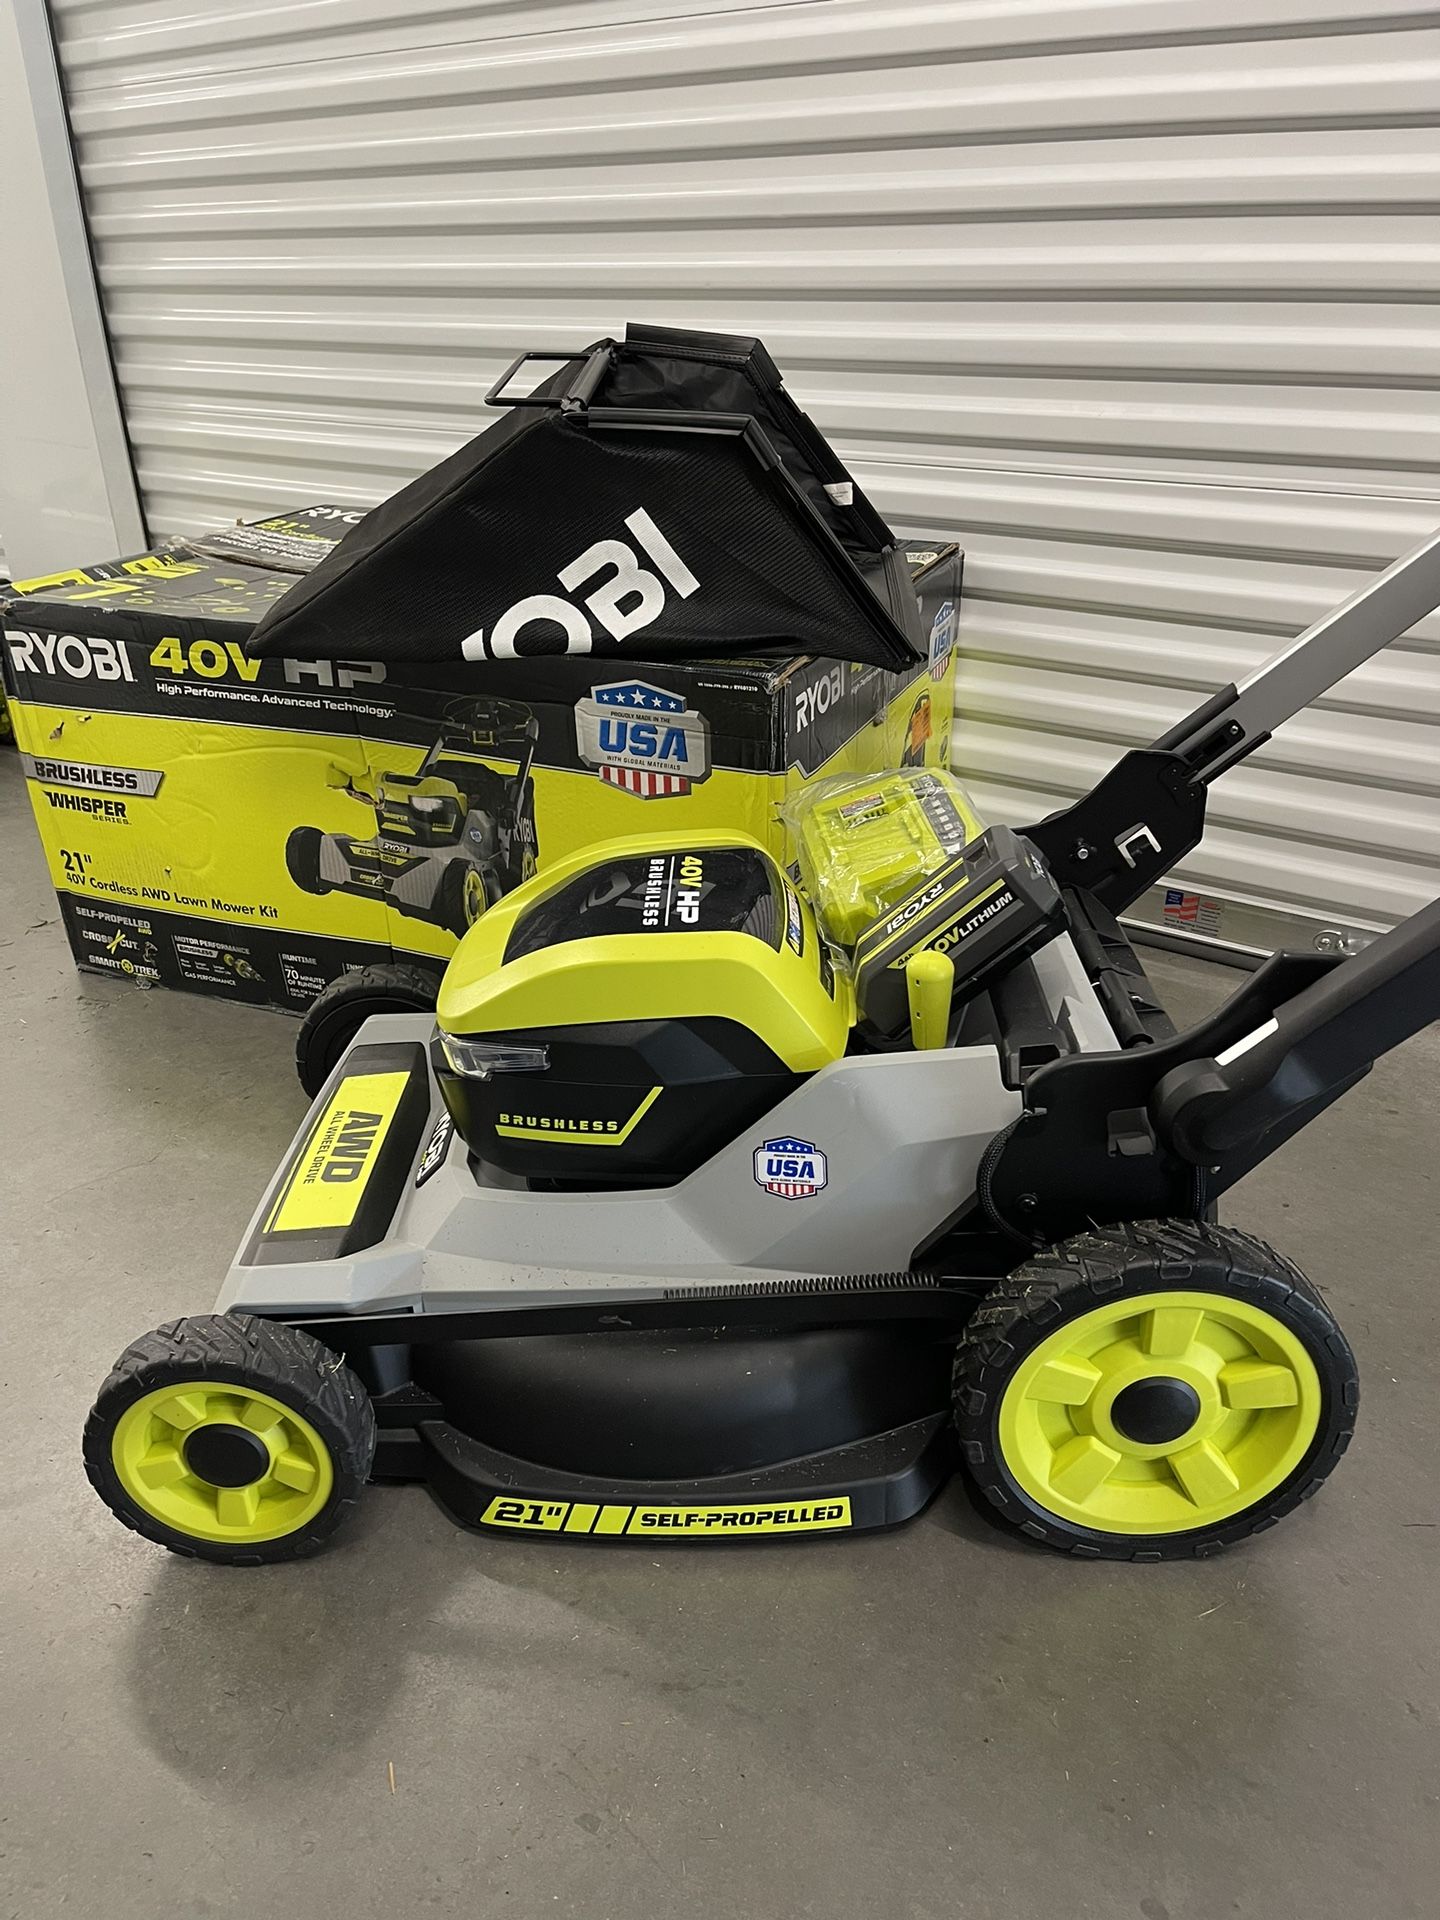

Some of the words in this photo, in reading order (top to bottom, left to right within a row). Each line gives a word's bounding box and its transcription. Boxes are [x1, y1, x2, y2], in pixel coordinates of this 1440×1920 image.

[461, 506, 701, 662] OBI
[5, 631, 136, 682] RYOBI
[150, 637, 263, 682] 40V
[283, 659, 388, 688] HP
[157, 683, 182, 696] High
[184, 686, 260, 702] Performance.
[262, 694, 321, 709] Advanced
[795, 661, 845, 733] RYOBI
[611, 711, 634, 719] PROUDLY
[599, 719, 688, 763] USA
[34, 761, 138, 790] BRUSHLESS
[623, 757, 645, 766] GLOBAL
[647, 760, 681, 771] MATERIALS
[43, 790, 127, 818] WHISPER
[60, 849, 91, 873] 21"
[680, 856, 703, 888] 40V
[66, 871, 86, 885] 40V
[90, 877, 138, 896] Cordless
[142, 886, 170, 901] AWD
[174, 892, 208, 908] Lawn
[211, 898, 255, 915] Mower
[259, 905, 279, 918] Kit
[642, 858, 665, 926] BRUSHLESS
[76, 906, 151, 928] SELF-PROPELLED
[676, 891, 700, 924] HP
[886, 883, 945, 934] RYOBI
[931, 926, 960, 952] 0V
[959, 892, 1014, 938] LITHIUM
[82, 930, 114, 944] CROSS
[174, 935, 199, 946] MOTOR
[199, 940, 250, 955] PERFORMANCE
[88, 955, 121, 969] SMART
[282, 953, 317, 965] RUNTIME
[184, 971, 196, 979] GAS
[196, 974, 236, 986] PERFORMANCE
[284, 968, 299, 980] 70
[300, 975, 326, 985] MINUTES
[297, 981, 323, 990] RUNTIME
[331, 1110, 345, 1125] ALL
[500, 1113, 619, 1132] BRUSHLESS
[316, 1126, 339, 1155] WHEEL
[321, 1110, 383, 1183] AWD
[303, 1156, 325, 1184] DRIVE
[766, 1159, 815, 1179] USA
[494, 1502, 562, 1525] 21"
[640, 1504, 845, 1528] SELF-PROPELLED
